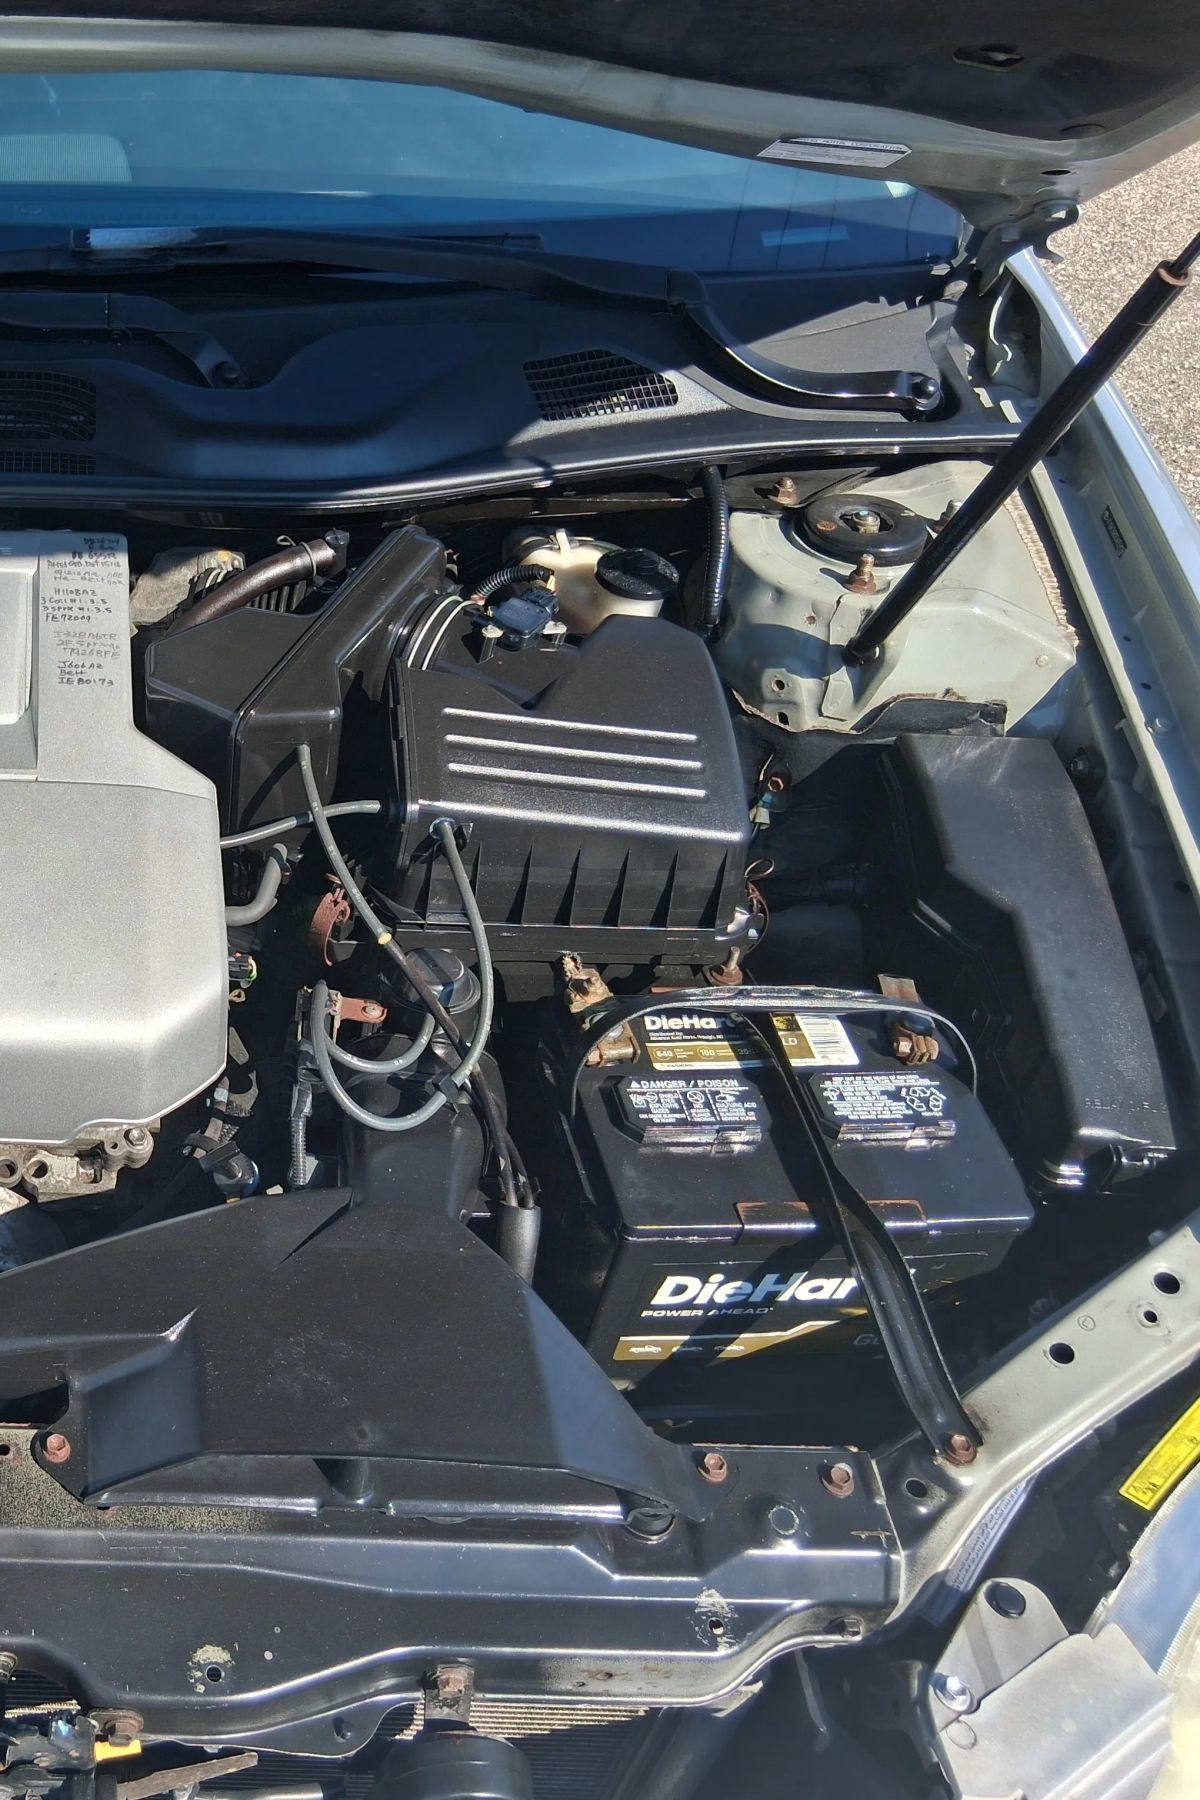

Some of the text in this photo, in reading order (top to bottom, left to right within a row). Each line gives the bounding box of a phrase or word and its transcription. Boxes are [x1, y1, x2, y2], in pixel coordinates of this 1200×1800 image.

[641, 1080, 687, 1089] DANGER
[698, 1079, 739, 1088] POISON
[650, 1271, 860, 1305] DieHar
[641, 1307, 768, 1317] POWER AHEAD
